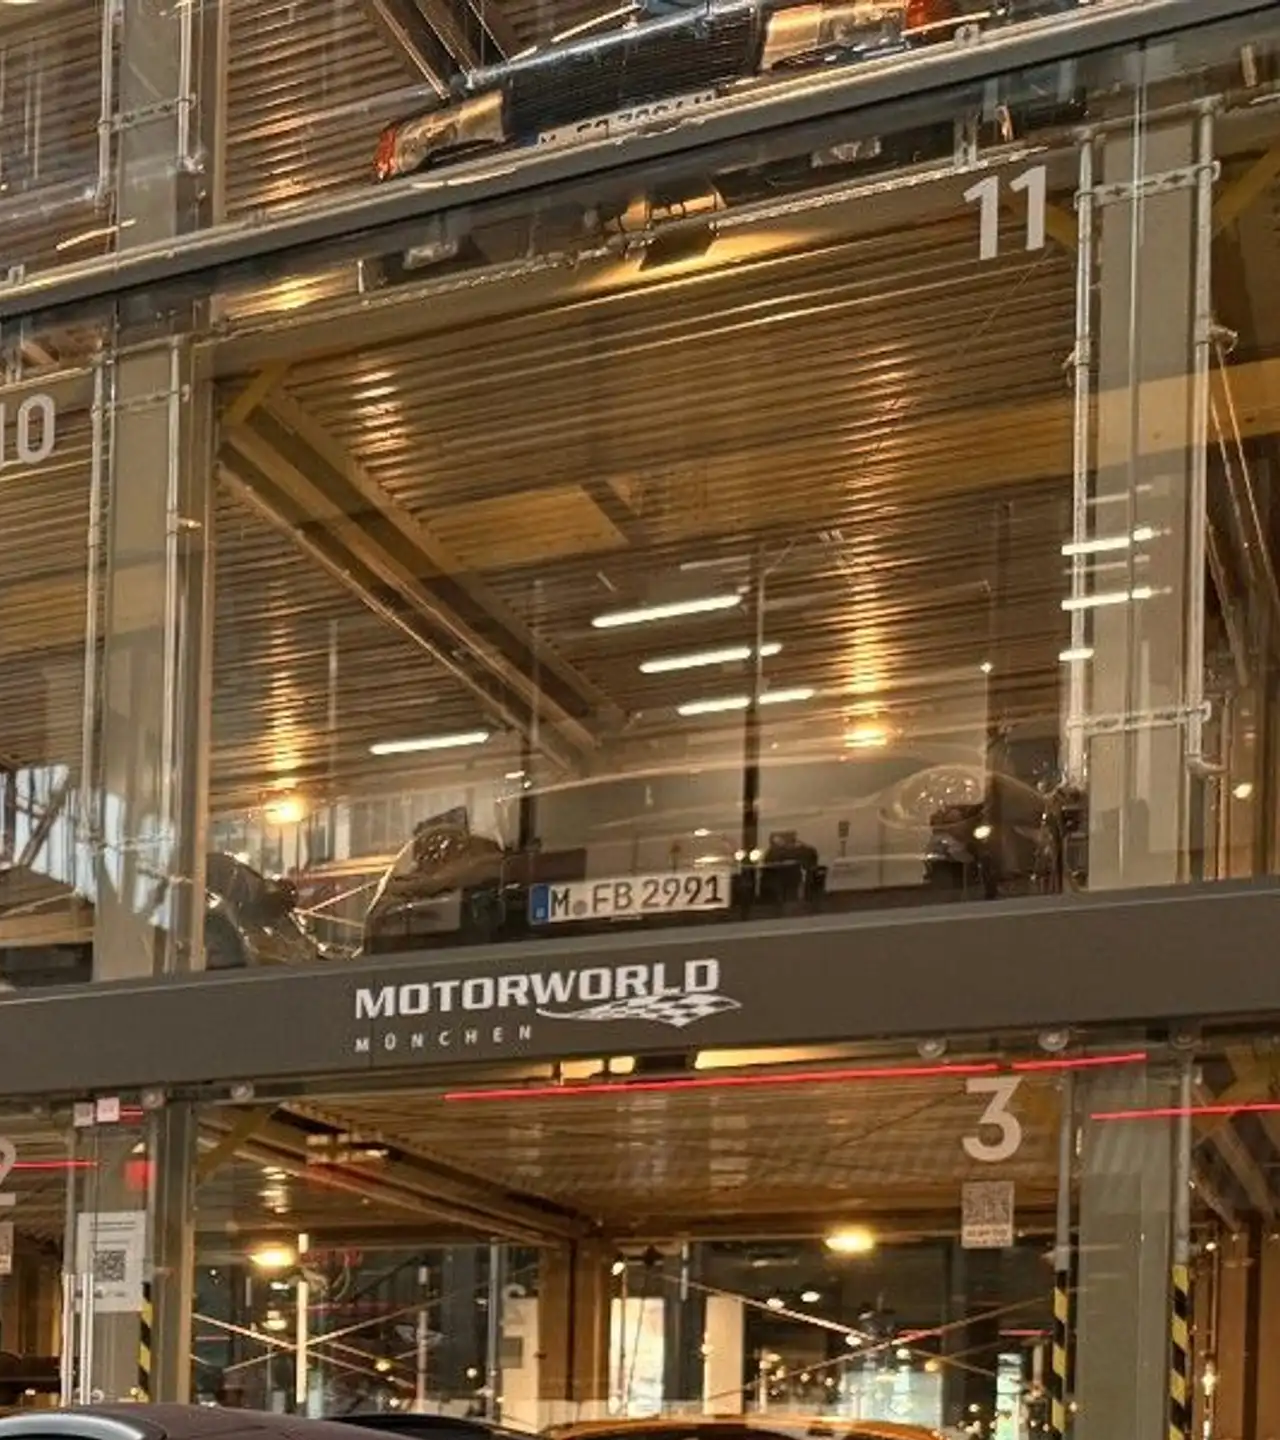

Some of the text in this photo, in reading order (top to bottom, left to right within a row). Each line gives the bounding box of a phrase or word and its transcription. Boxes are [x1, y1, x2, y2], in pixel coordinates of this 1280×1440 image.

[963, 165, 1046, 260] 11
[551, 875, 725, 917] M FB 2991
[354, 957, 720, 1020] MOTORWORLD
[962, 1075, 1024, 1162] 3
